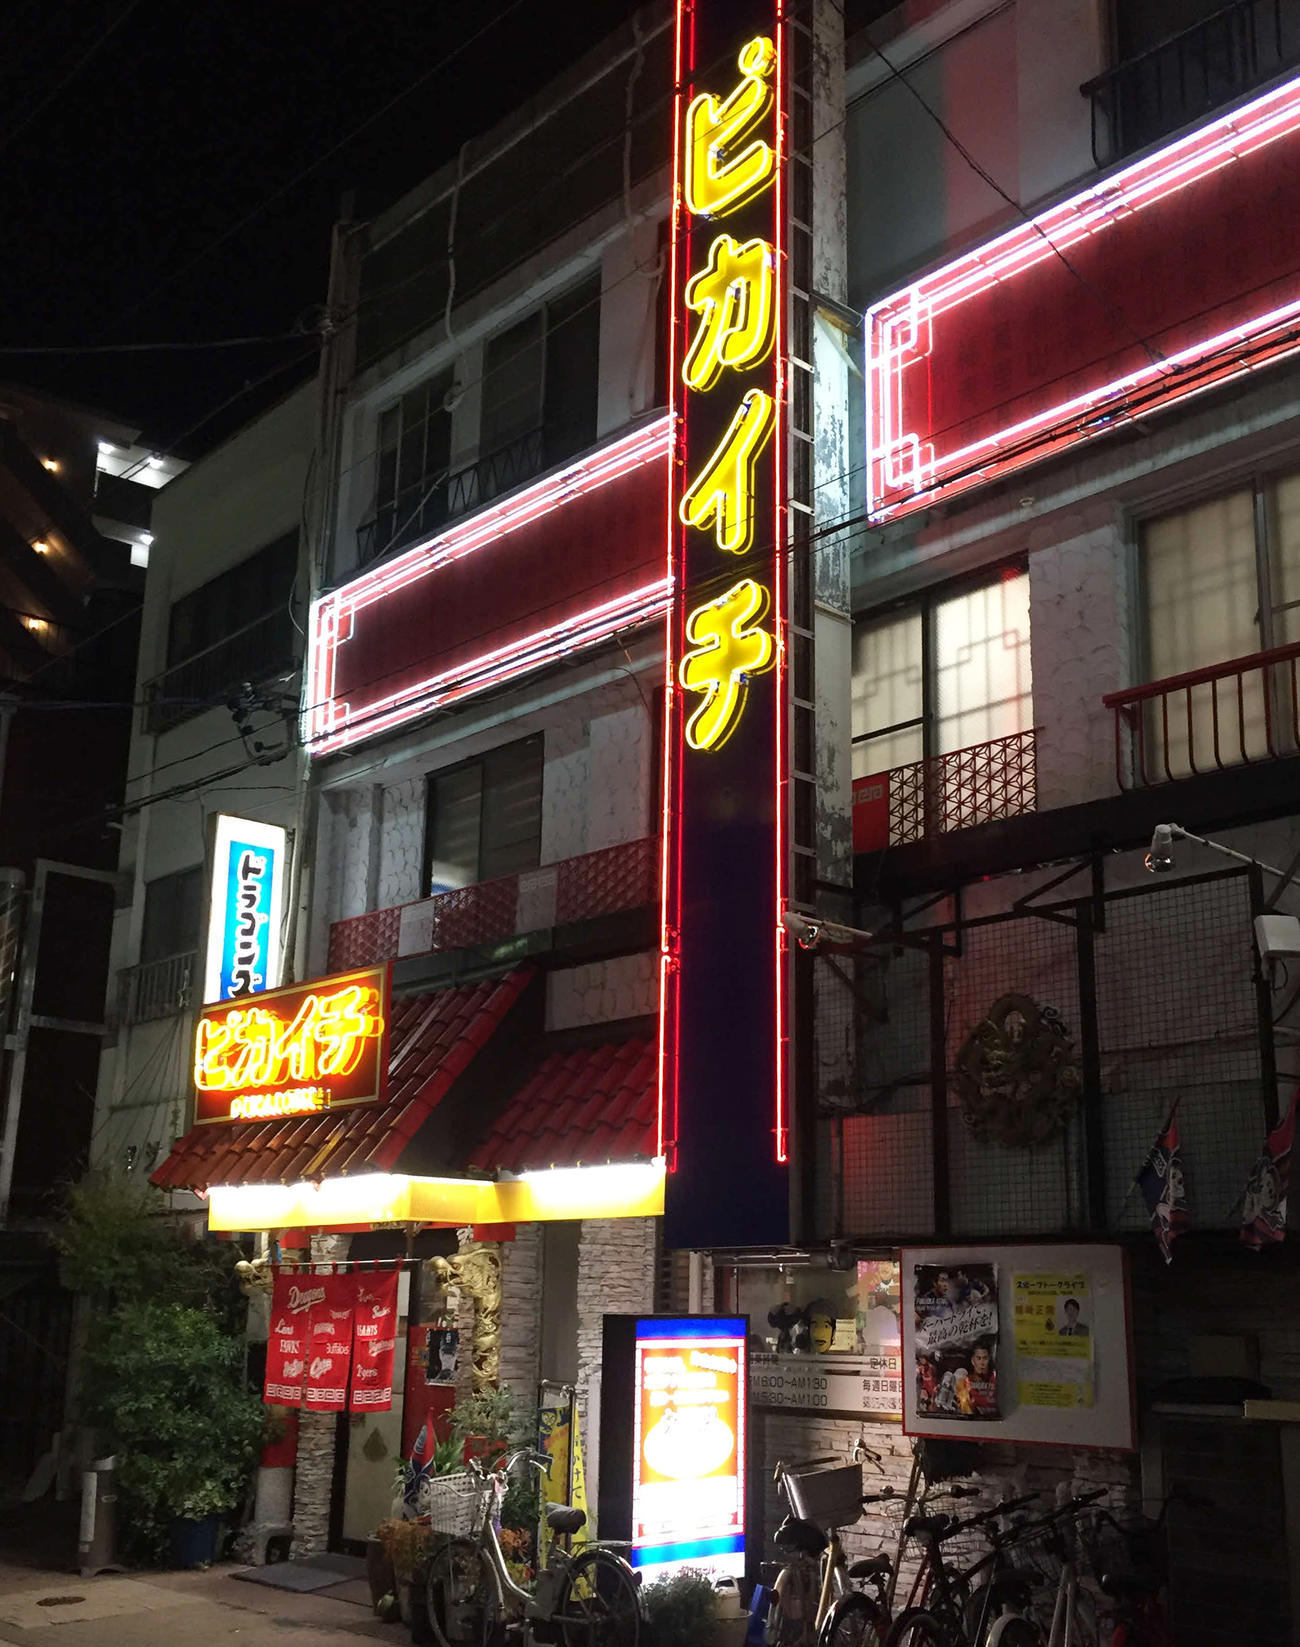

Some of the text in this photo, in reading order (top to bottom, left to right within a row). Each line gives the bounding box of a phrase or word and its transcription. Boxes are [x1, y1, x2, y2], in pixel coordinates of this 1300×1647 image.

[680, 37, 777, 751] ピカイチ
[194, 985, 384, 1091] ピカイチ
[287, 1286, 326, 1314] Dragons
[869, 1357, 897, 1370] 定休日
